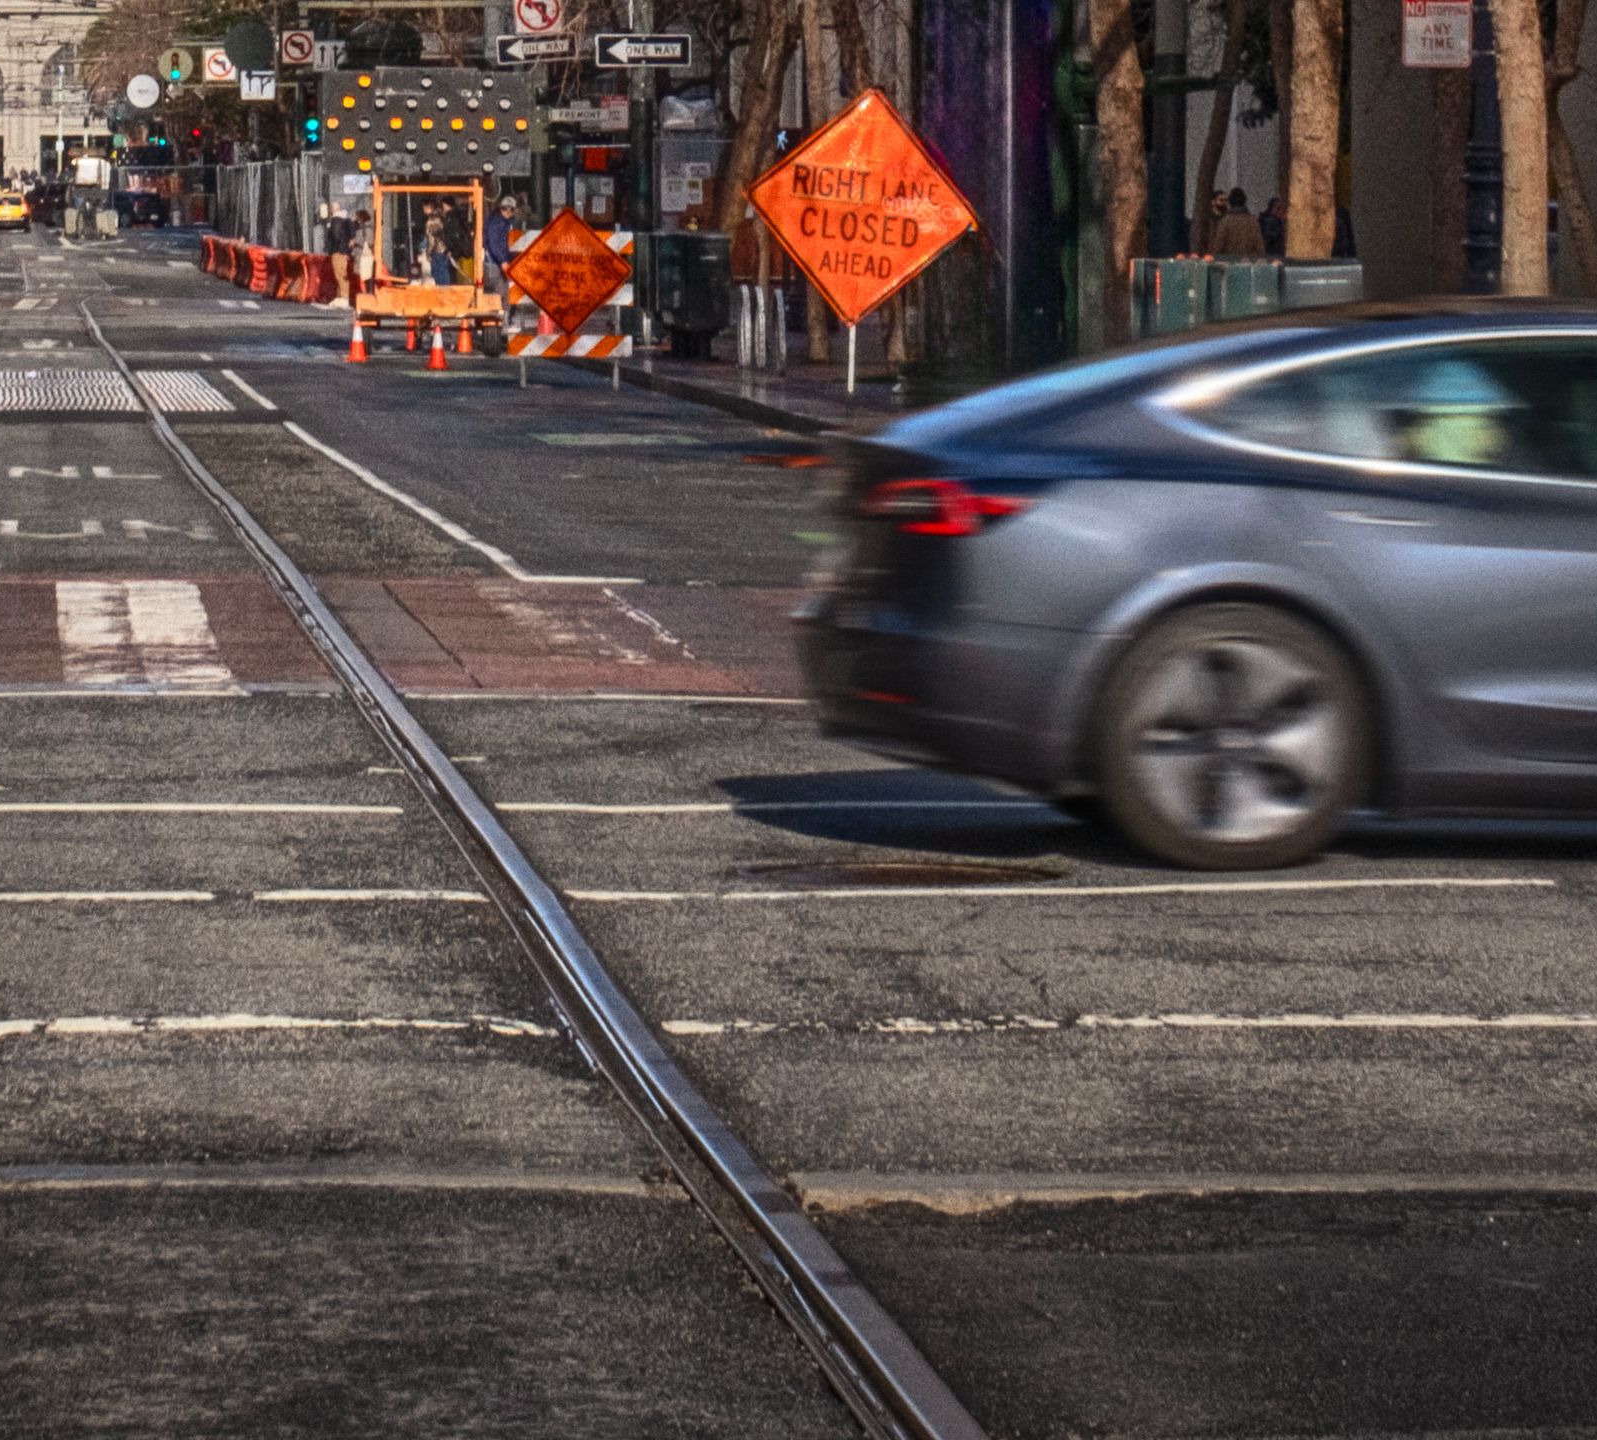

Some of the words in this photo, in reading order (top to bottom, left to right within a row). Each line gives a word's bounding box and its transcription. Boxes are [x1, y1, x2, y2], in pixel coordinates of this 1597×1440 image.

[1406, 1, 1425, 16] NO
[1424, 23, 1452, 35] ANY
[522, 43, 540, 54] ONE
[546, 40, 565, 52] WAY
[1421, 37, 1454, 51] TIME
[626, 46, 646, 57] ONE
[655, 46, 678, 57] WAY
[792, 163, 870, 203] RIGHT
[881, 178, 940, 205] LANE
[800, 207, 919, 248] CLOSED
[819, 250, 892, 279] AHEAD
